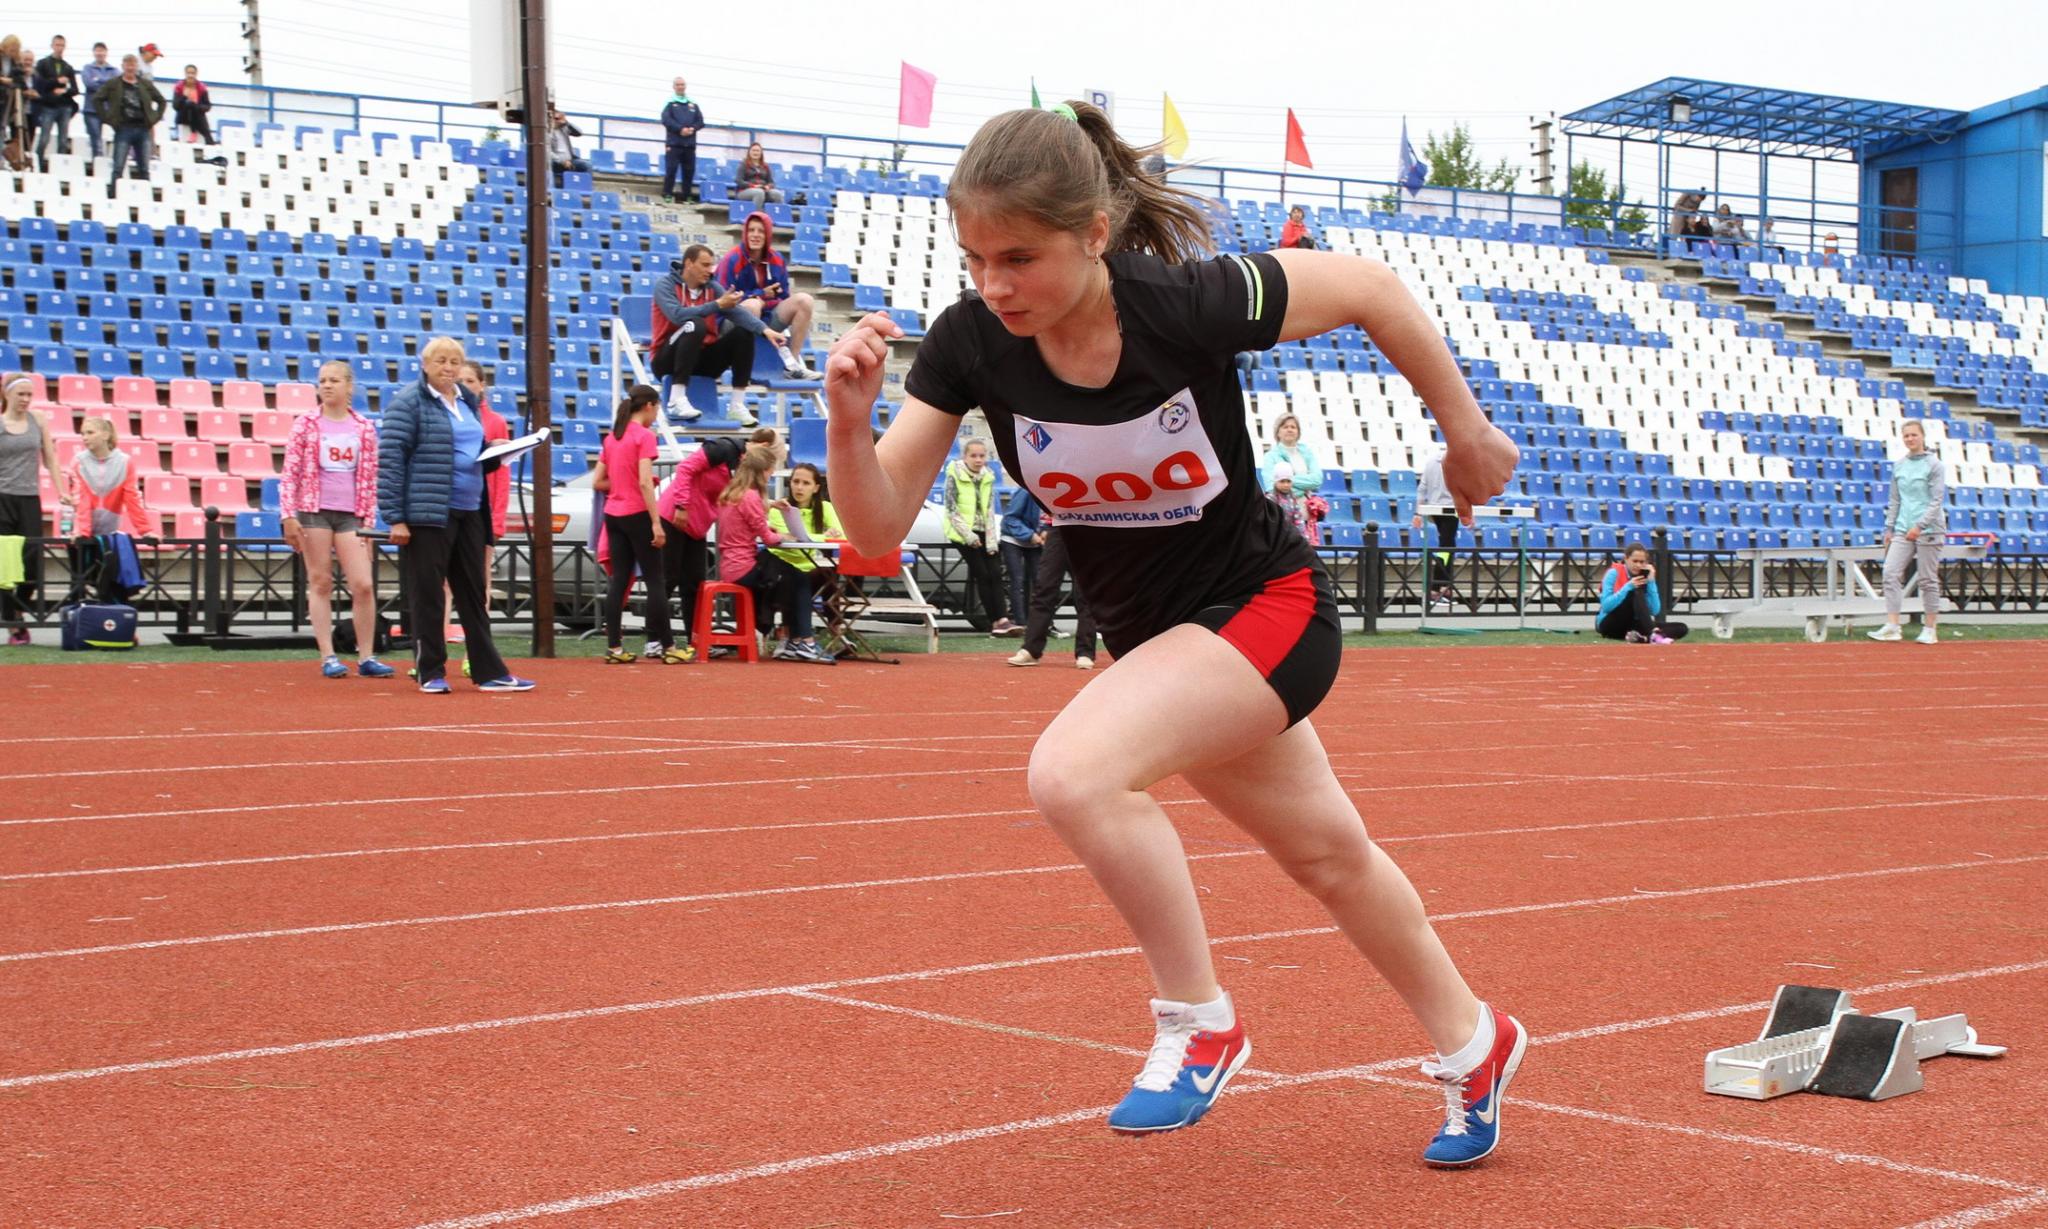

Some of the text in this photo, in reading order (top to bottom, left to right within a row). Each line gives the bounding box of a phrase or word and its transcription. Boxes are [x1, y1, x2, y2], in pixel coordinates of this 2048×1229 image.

[588, 398, 598, 407] 24
[575, 424, 585, 433] 23
[328, 447, 353, 462] 84
[562, 454, 572, 463] 22
[1039, 450, 1210, 509] 200
[1057, 510, 1160, 523] САХАЛИНСКАЯ
[252, 517, 261, 526] 15
